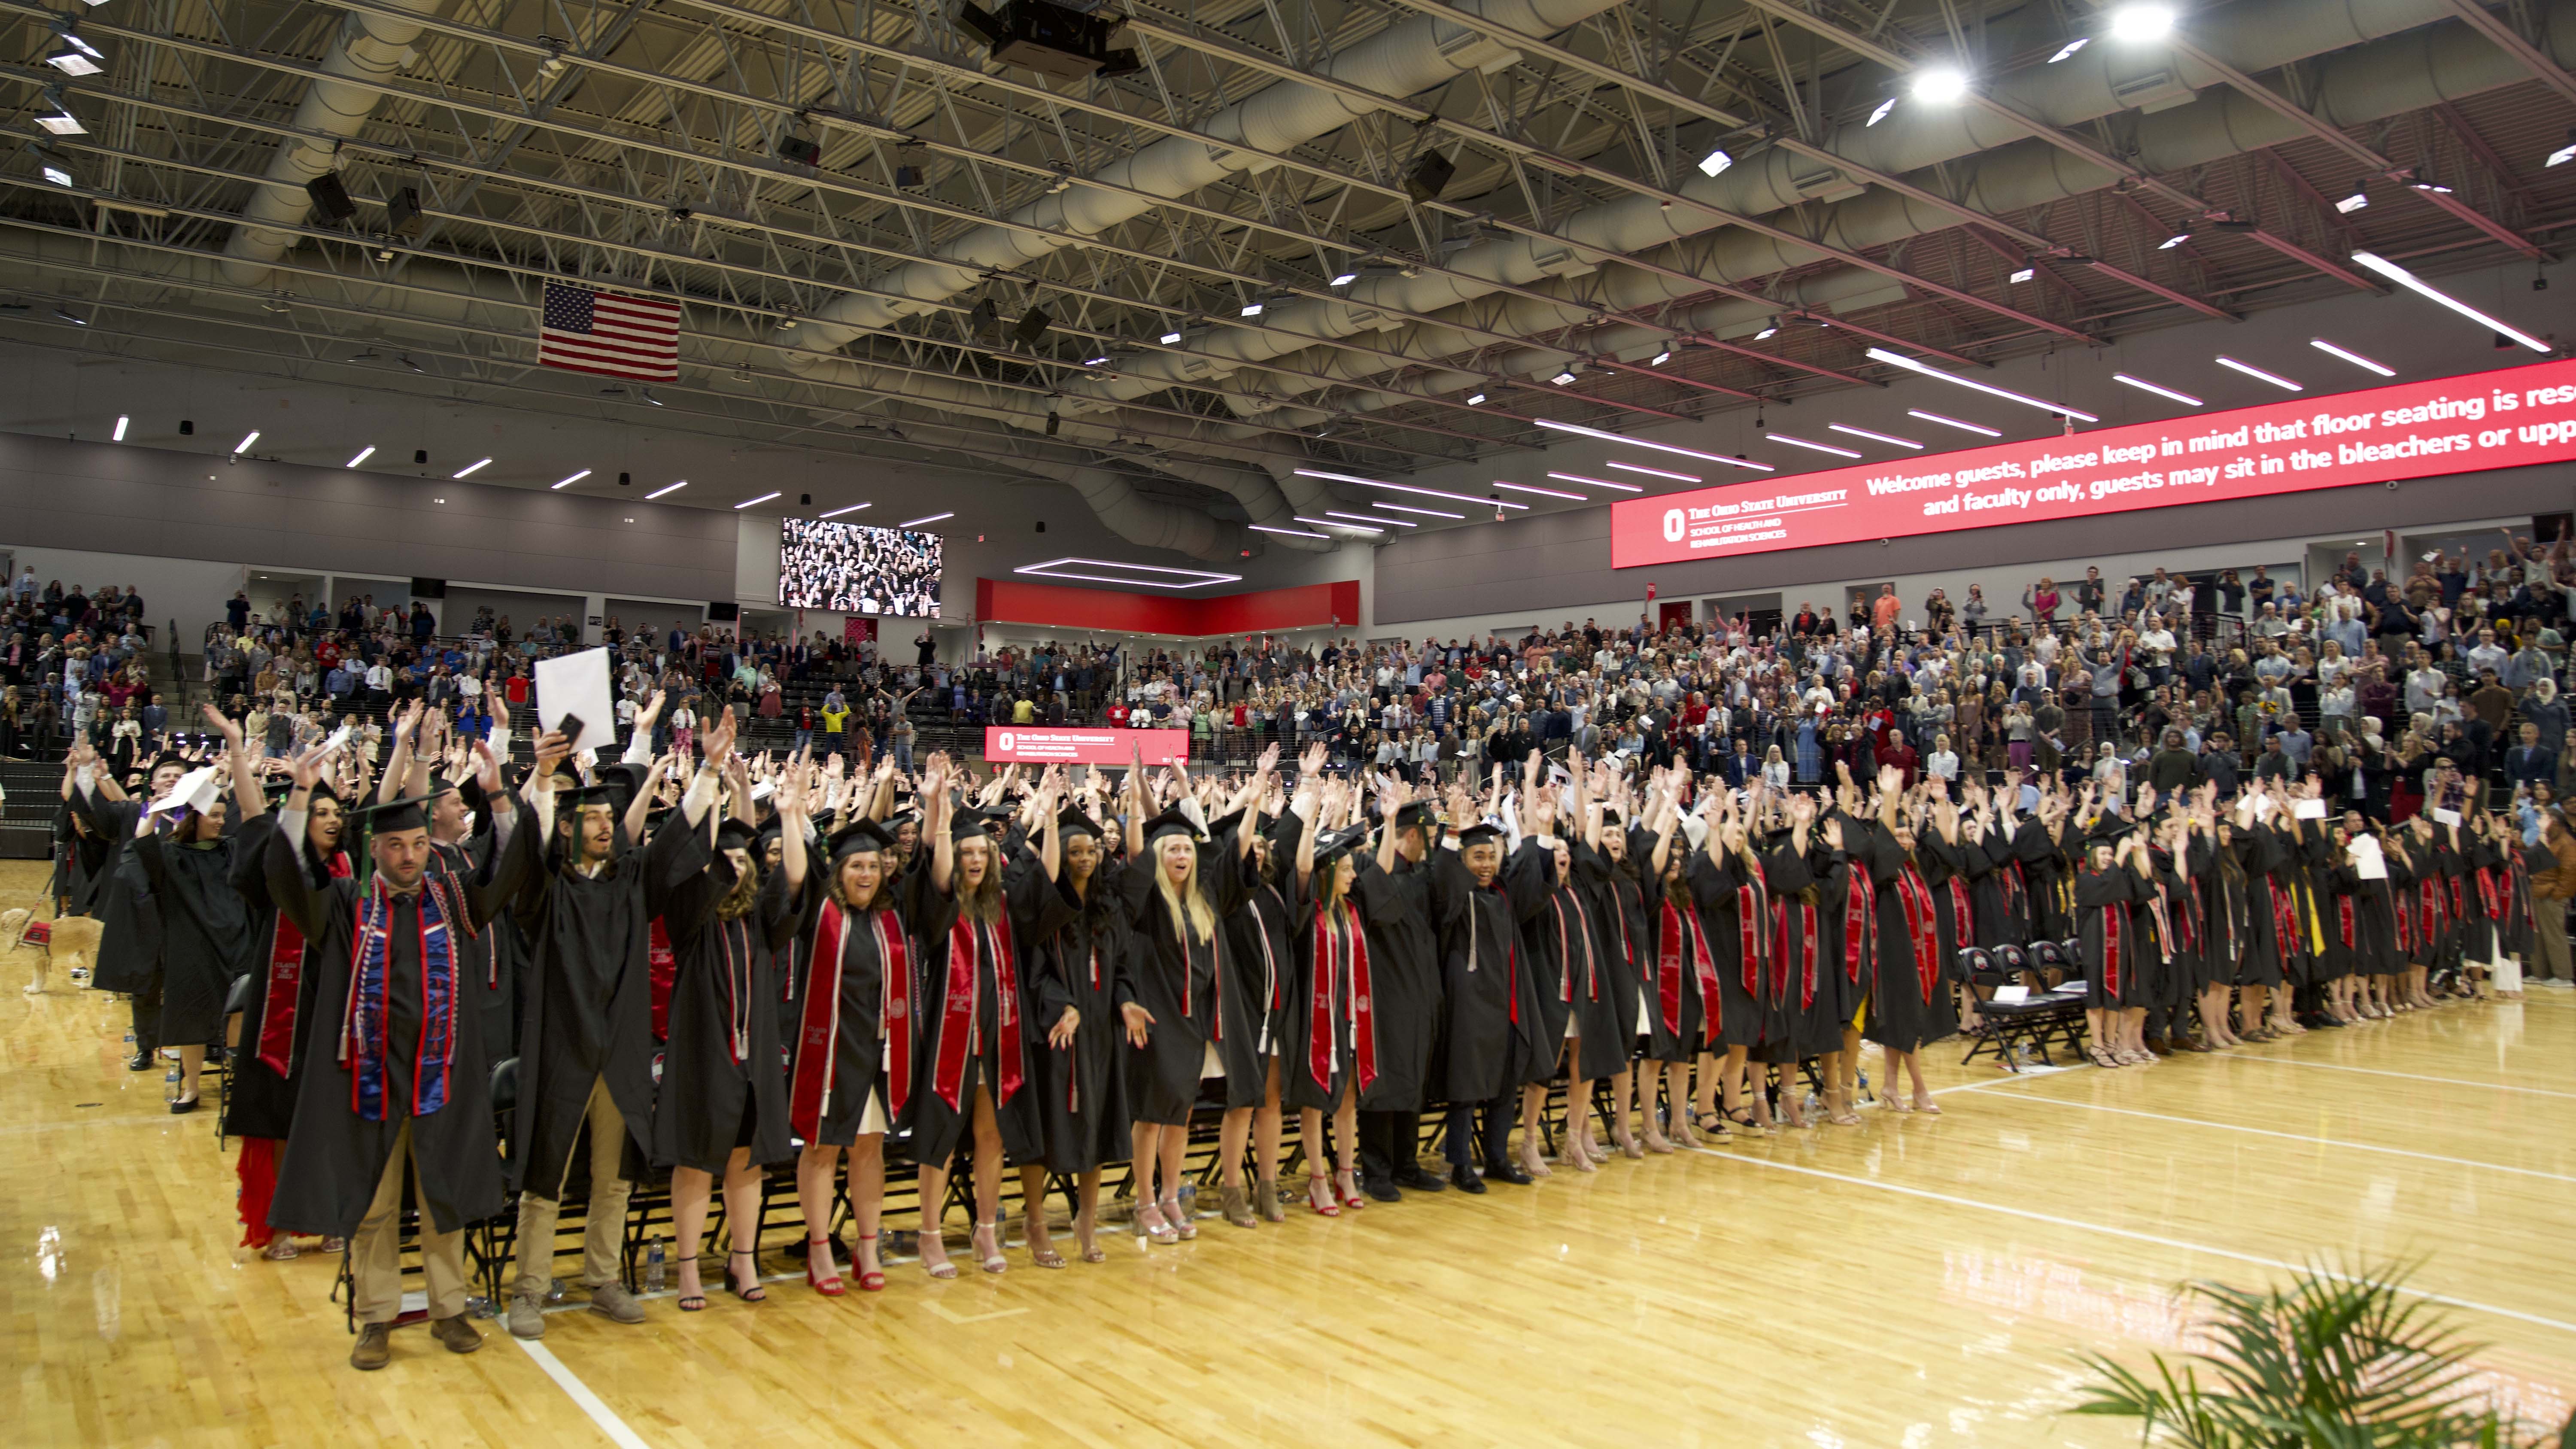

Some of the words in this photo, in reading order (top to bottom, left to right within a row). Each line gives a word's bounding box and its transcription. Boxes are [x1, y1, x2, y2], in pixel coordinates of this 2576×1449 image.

[1866, 472, 1951, 495] Welcome
[1955, 462, 2026, 488] guests,
[2031, 452, 2098, 478] please
[2103, 444, 2156, 464] keep
[2161, 437, 2183, 456] in
[2189, 425, 2248, 452] mind
[2254, 419, 2307, 443] that
[2311, 413, 2376, 435] floor
[2381, 397, 2485, 426] seating
[2493, 389, 2518, 411] is
[2527, 385, 2576, 407] res
[1923, 494, 1959, 515] and
[1963, 488, 2032, 511] faculty
[2035, 480, 2085, 502] only,
[2090, 471, 2164, 499] guests
[2169, 466, 2219, 486] may
[2224, 457, 2256, 478] sit
[2260, 454, 2284, 474] in
[2289, 449, 2332, 470] the
[2339, 434, 2471, 465] bleachers
[2478, 428, 2511, 447] or
[1688, 508, 1710, 519] THE
[1712, 504, 1740, 516] OHIO
[1741, 500, 1774, 513] STATE
[1776, 489, 1847, 508] UNIVERSITY
[1690, 526, 1722, 537] SCHOOL
[1722, 524, 1733, 533] OF
[1734, 520, 1764, 531] HEALTH
[1763, 518, 1782, 527] AND
[1748, 529, 1787, 542] SCIENCES
